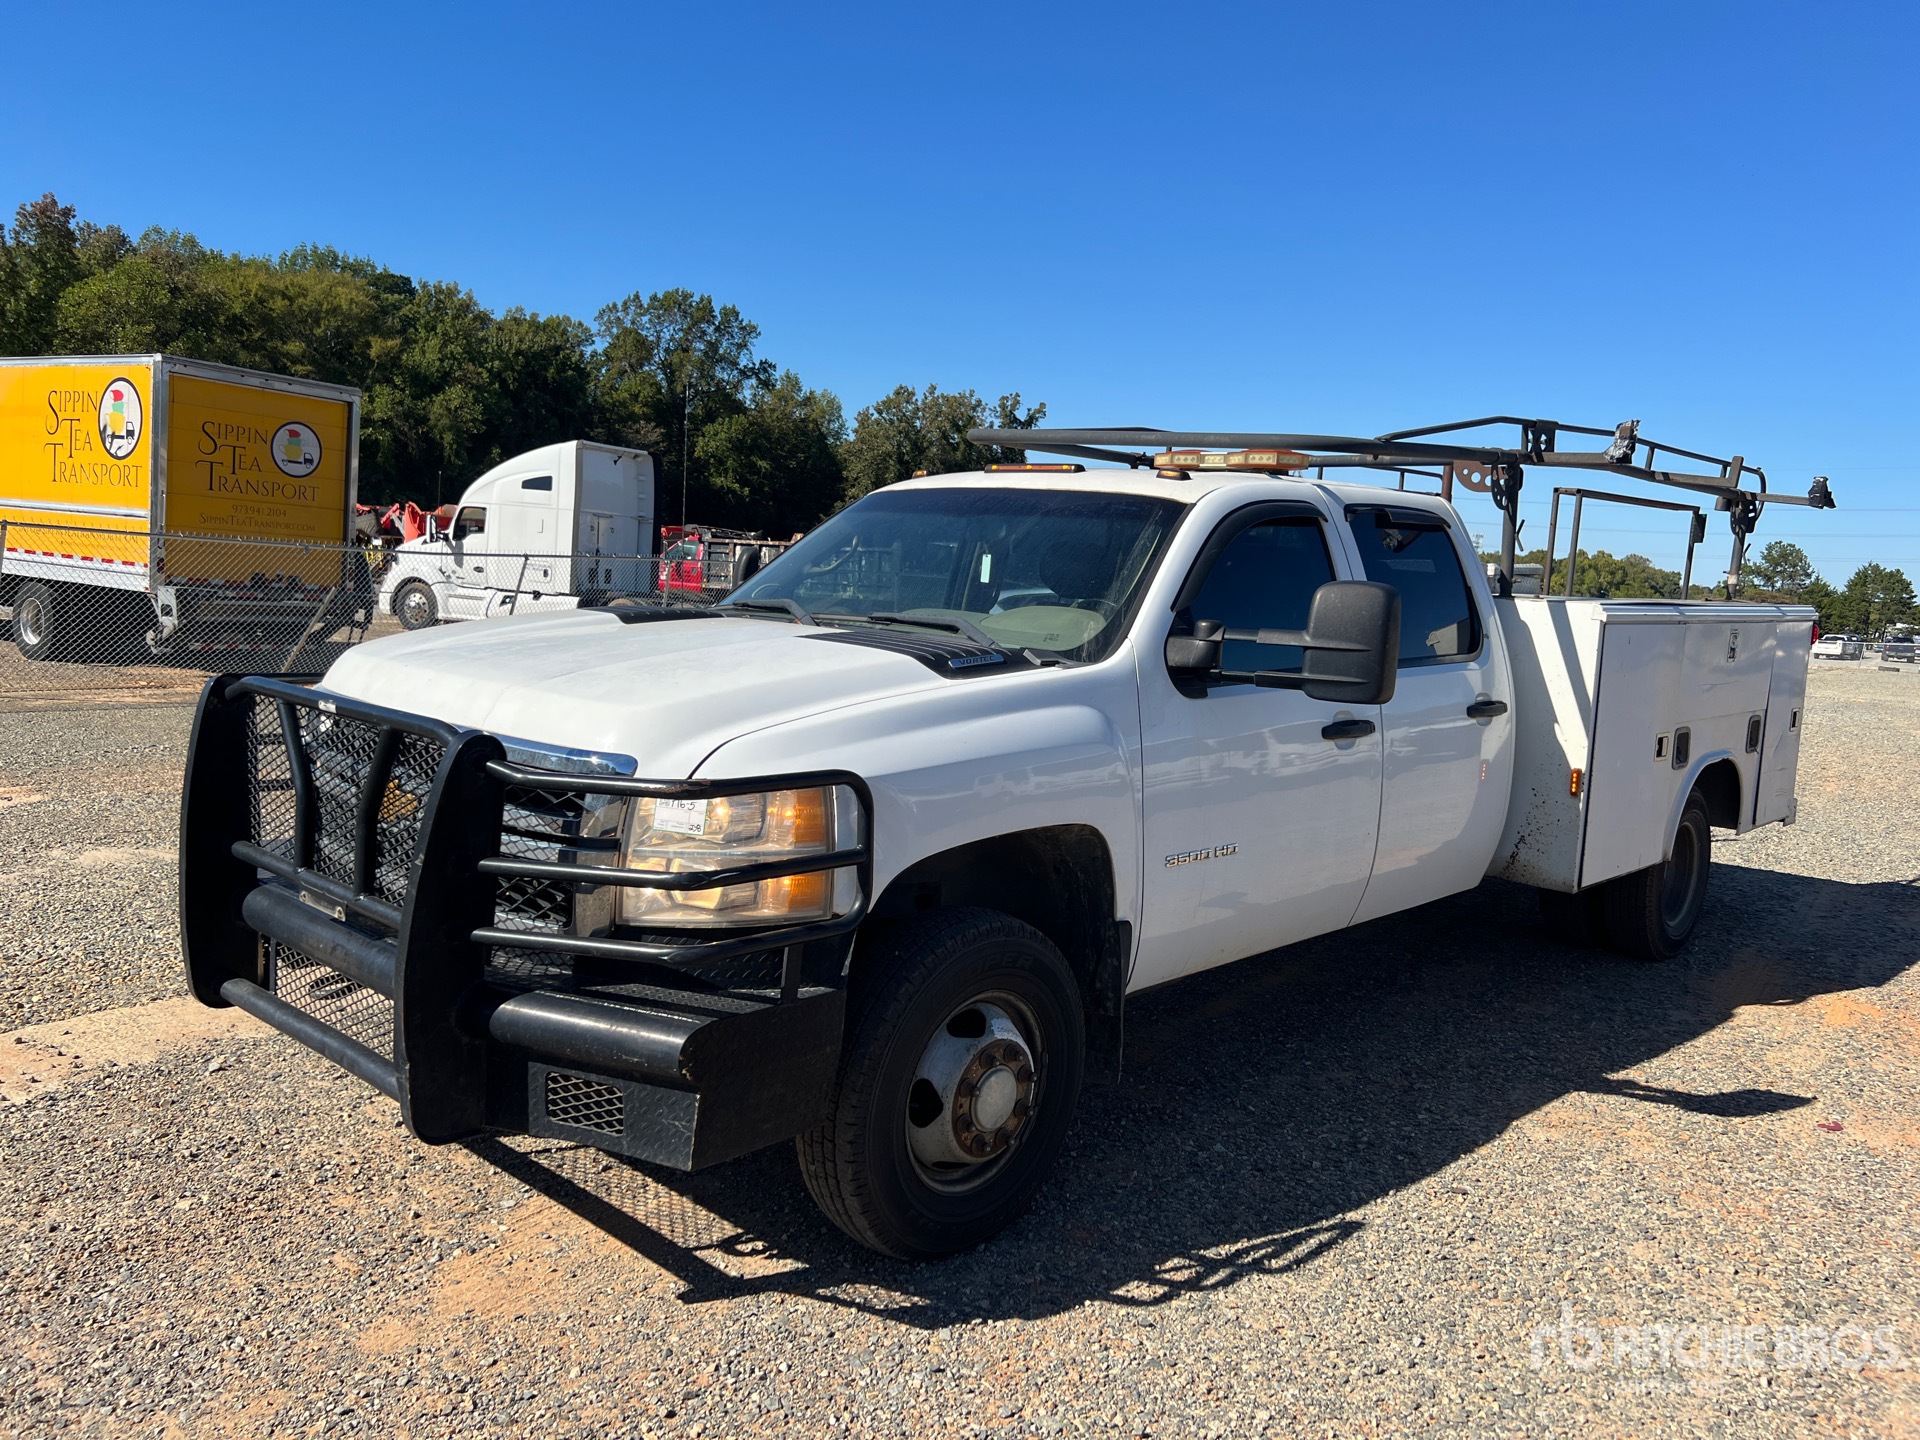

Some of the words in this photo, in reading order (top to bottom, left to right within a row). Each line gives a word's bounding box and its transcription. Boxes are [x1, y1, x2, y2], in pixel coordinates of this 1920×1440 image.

[60, 418, 93, 458] TEA
[44, 442, 143, 488] TRANSPORT
[219, 444, 262, 475] TEA
[194, 459, 320, 501] TRANSPORT
[958, 655, 995, 665] VORTEC
[1164, 847, 1213, 868] 3500
[1214, 842, 1239, 858] HD
